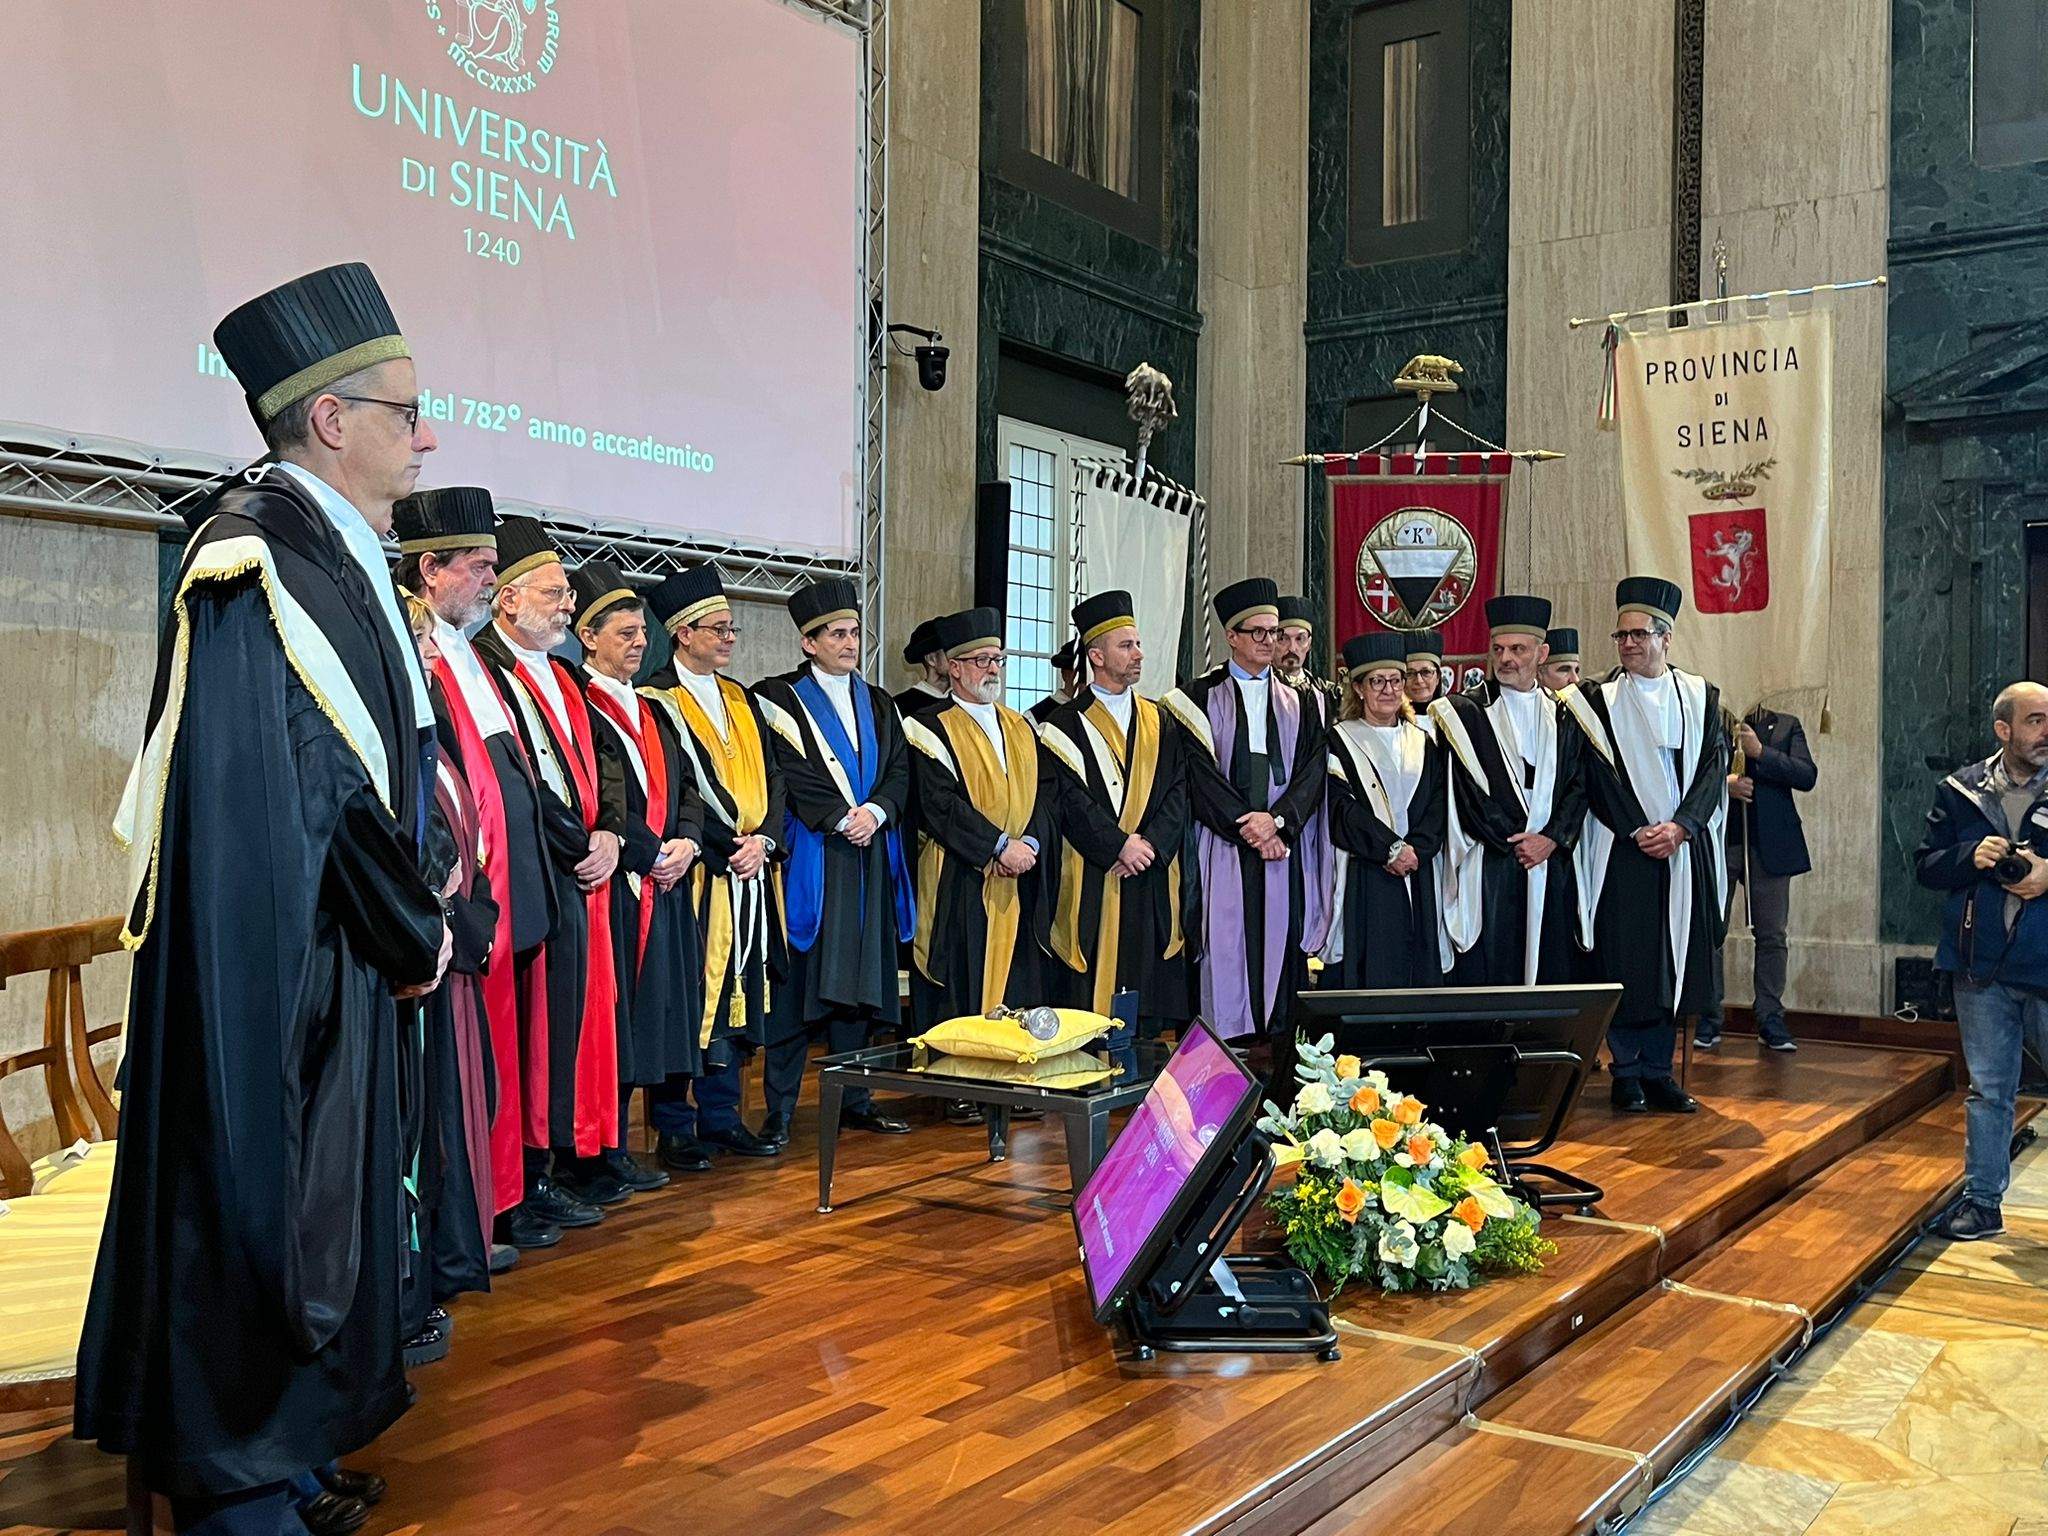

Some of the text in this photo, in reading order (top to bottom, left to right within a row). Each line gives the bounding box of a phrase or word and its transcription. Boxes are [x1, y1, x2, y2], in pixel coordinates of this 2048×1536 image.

[352, 63, 617, 197] UNIVERSITÀ
[402, 157, 575, 240] DI SIENA
[463, 228, 521, 266] 1240
[1645, 346, 1799, 385] PROVINCIA
[1715, 392, 1729, 406] DI
[418, 389, 455, 421] del
[528, 417, 586, 448] anno
[592, 431, 715, 473] accademico
[1678, 416, 1769, 448] SIENA
[1412, 527, 1424, 544] K
